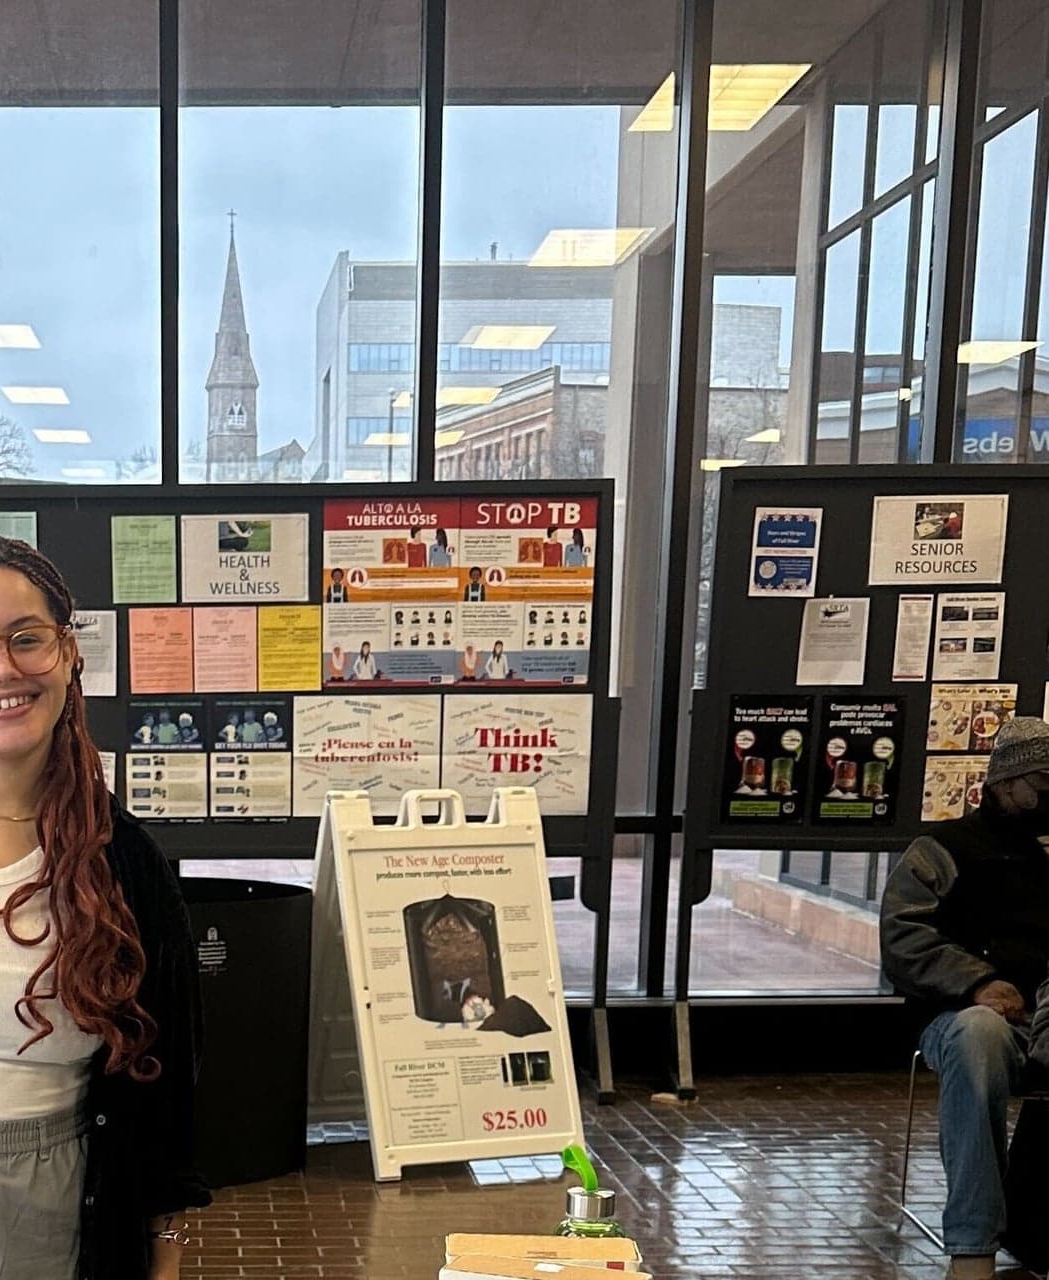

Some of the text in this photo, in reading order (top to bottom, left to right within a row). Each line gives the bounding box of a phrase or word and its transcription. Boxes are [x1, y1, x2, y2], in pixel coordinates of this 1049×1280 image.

[362, 502, 422, 514] ALTO A LA
[477, 502, 582, 525] STOP TB
[346, 514, 438, 527] TUBERCULOSIS
[910, 543, 964, 556] SENIOR
[219, 555, 271, 569] HEALTH
[894, 560, 978, 574] RESOURCES
[239, 569, 250, 581] &
[209, 582, 281, 595] WELLNESS
[322, 738, 413, 752] ¡Piense en la
[474, 728, 558, 748] Think
[314, 751, 419, 763] tuberculosis!
[488, 752, 543, 773] TB!
[383, 853, 504, 869] The New Age Composter
[482, 1107, 548, 1132] $25.00
